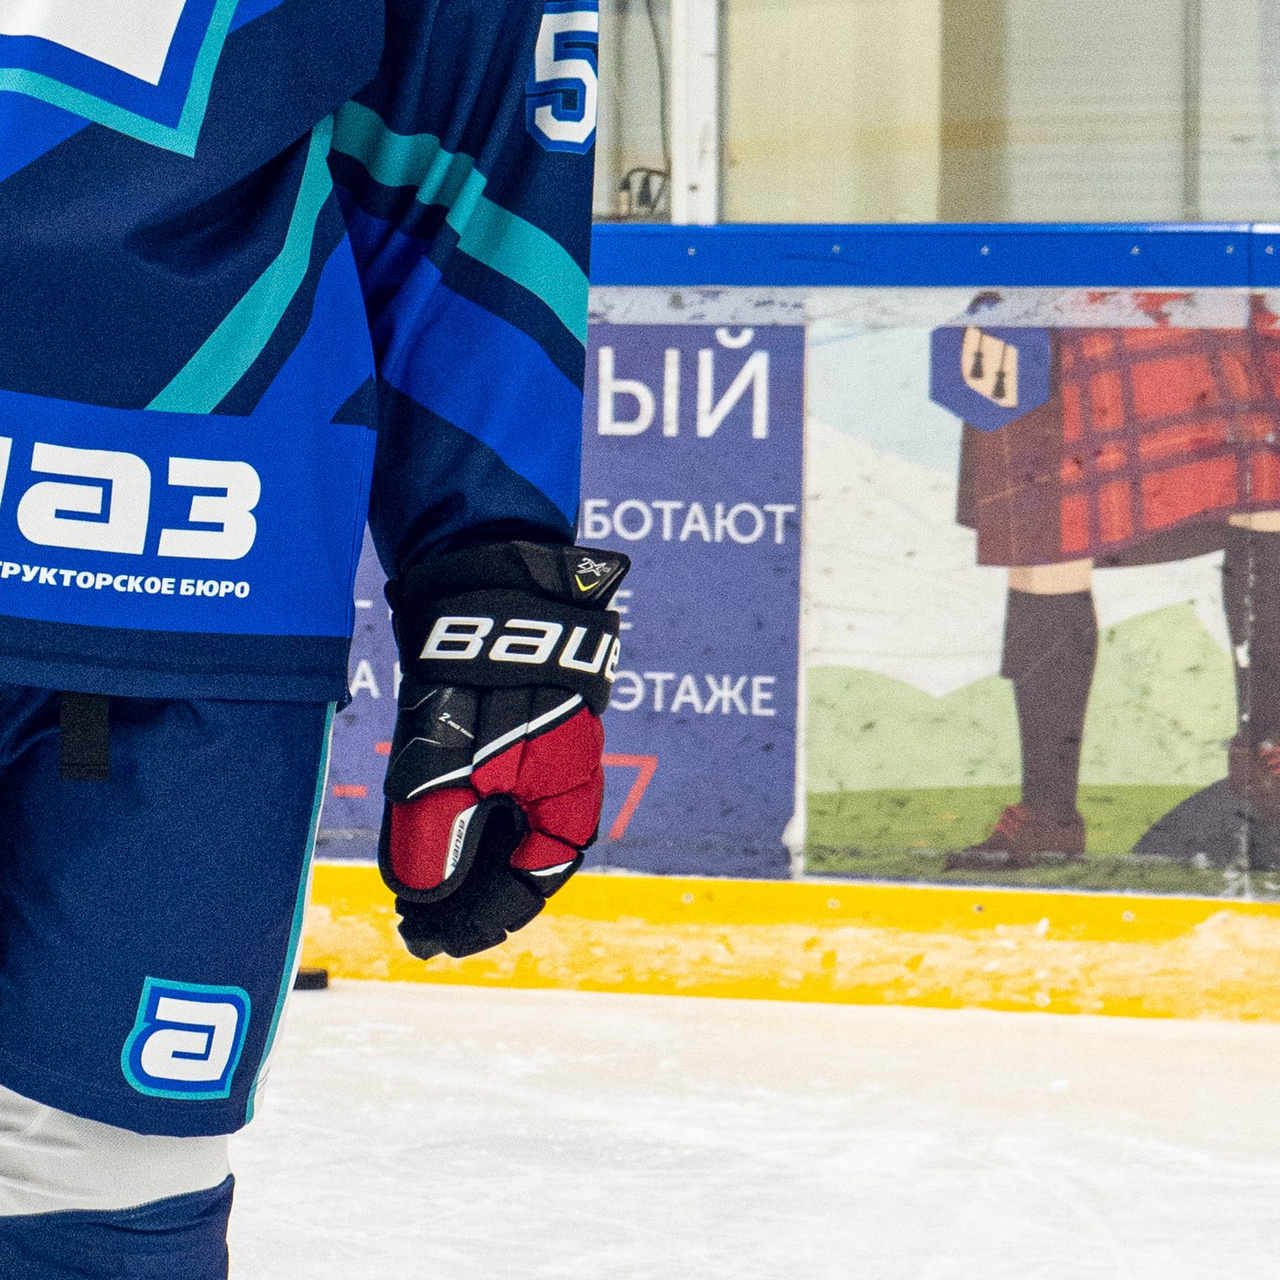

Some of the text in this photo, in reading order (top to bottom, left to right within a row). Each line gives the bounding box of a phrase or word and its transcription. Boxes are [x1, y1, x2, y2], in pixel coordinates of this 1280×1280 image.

[577, 499, 797, 545] БОТАЮТ
[179, 578, 251, 599] БЮРО
[610, 670, 777, 717] ЭТАЖЕ
